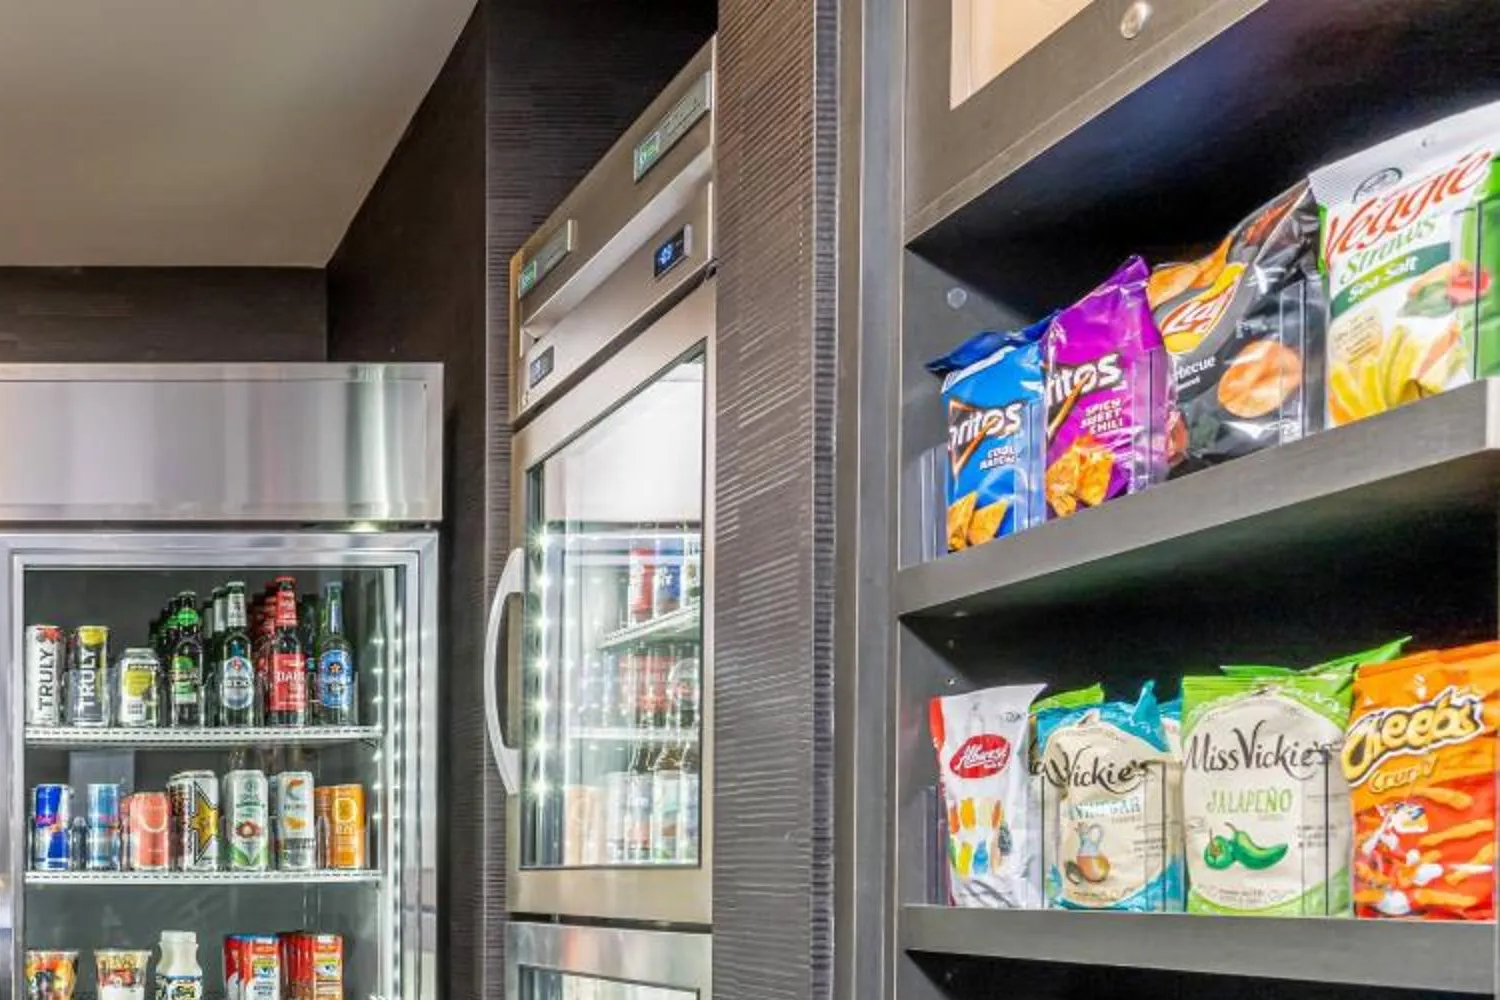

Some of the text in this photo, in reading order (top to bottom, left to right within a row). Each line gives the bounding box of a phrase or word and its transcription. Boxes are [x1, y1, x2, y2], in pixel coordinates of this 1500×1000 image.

[38, 648, 54, 711] TRULY
[80, 647, 97, 707] TRULY
[1184, 719, 1334, 781] Miss Vickie's
[1207, 788, 1293, 815] JALAPEÑO
